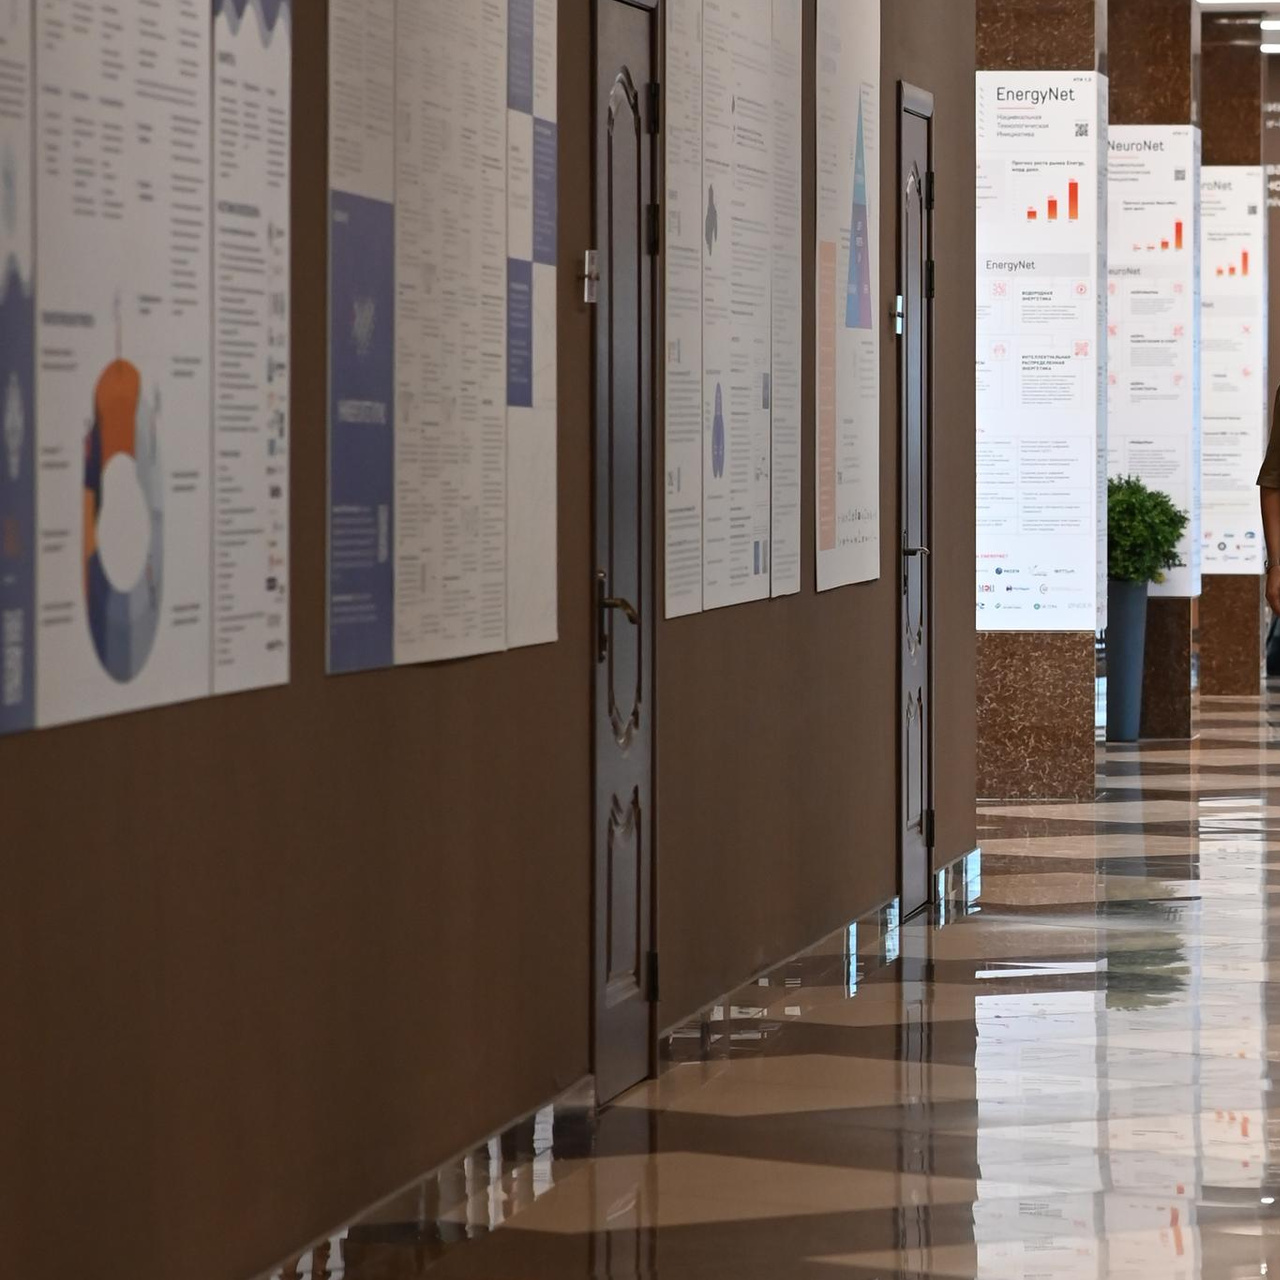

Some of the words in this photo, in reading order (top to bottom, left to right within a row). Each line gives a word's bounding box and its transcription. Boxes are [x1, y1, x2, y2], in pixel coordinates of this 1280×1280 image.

[996, 86, 1076, 105] EnergyNet
[1107, 140, 1165, 152] NeuroNet
[985, 259, 1036, 272] EnergyNet
[1108, 267, 1141, 276] euroNet
